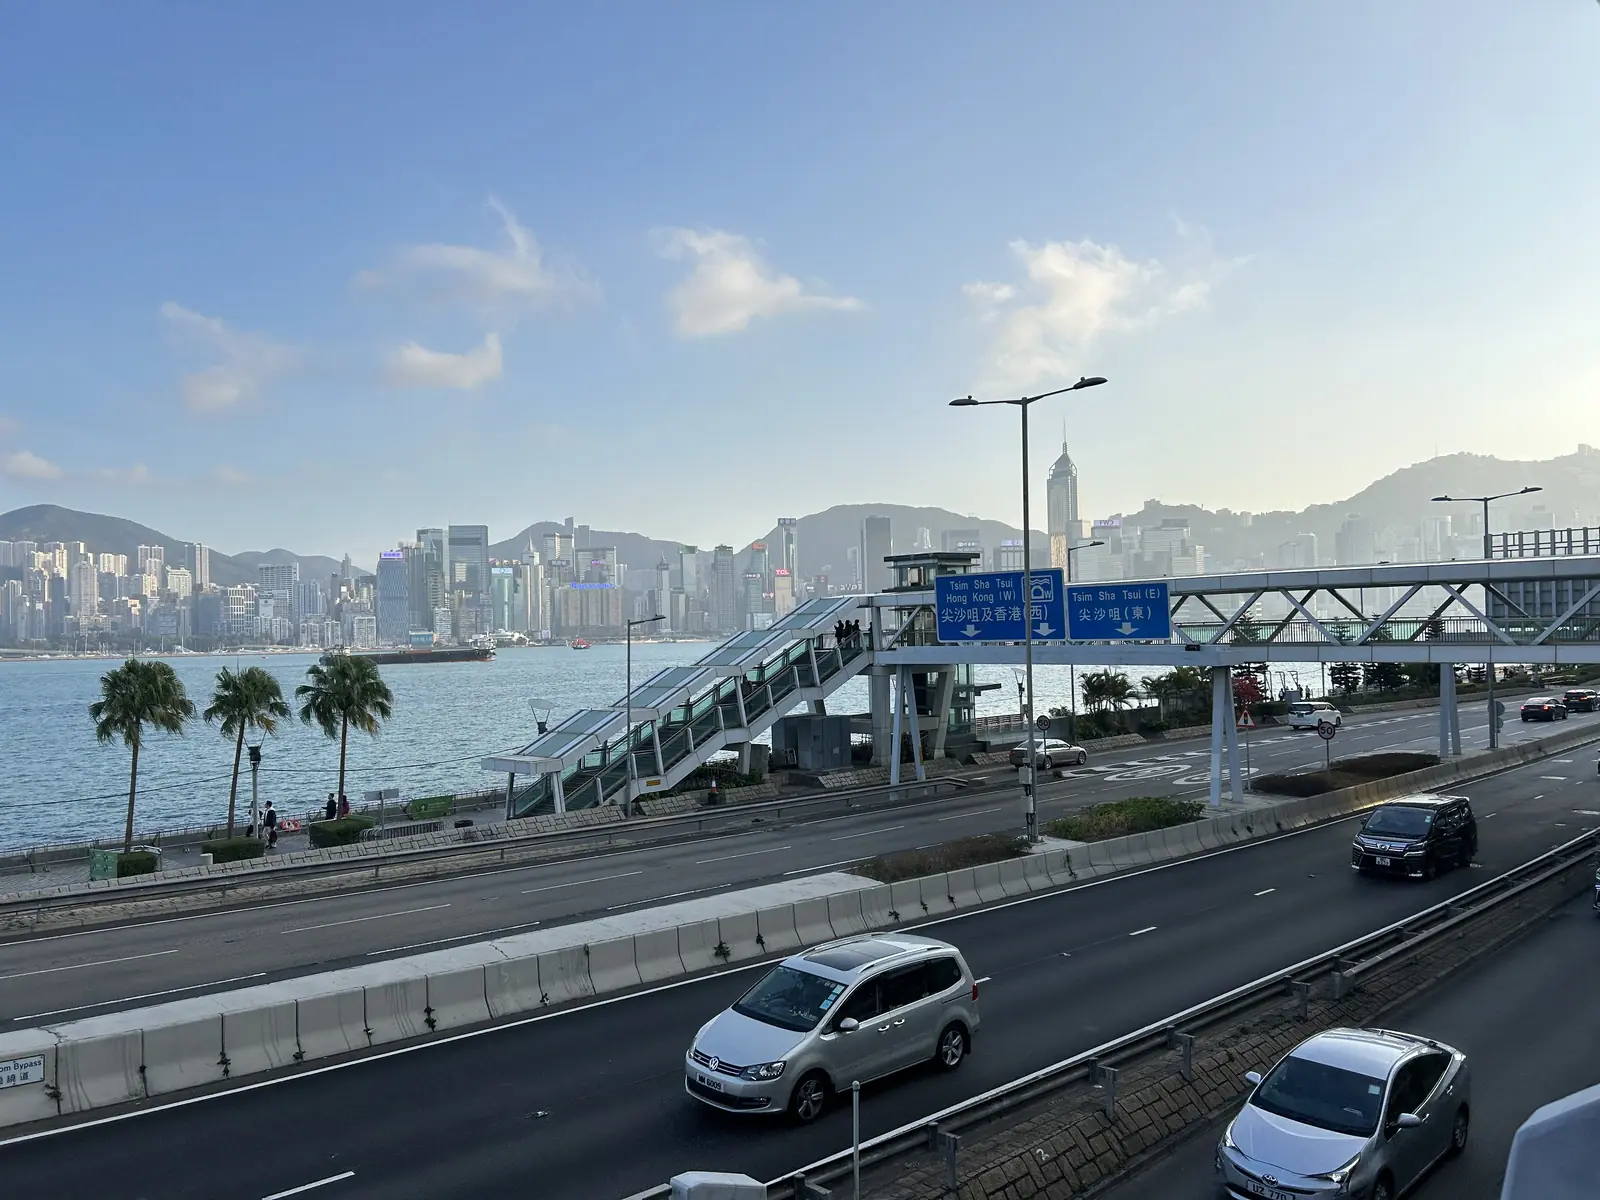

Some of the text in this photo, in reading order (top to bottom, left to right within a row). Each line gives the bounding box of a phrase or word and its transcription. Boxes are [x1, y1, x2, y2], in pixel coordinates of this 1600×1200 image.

[950, 578, 1013, 591] Tsim Sha Tsui
[946, 590, 1016, 604] Hong Kong (W)
[1072, 588, 1160, 602] Tsim Sha Tsui (E)
[1038, 719, 1048, 727] 50
[1320, 726, 1333, 735] 50
[14, 1060, 42, 1070] Bypass
